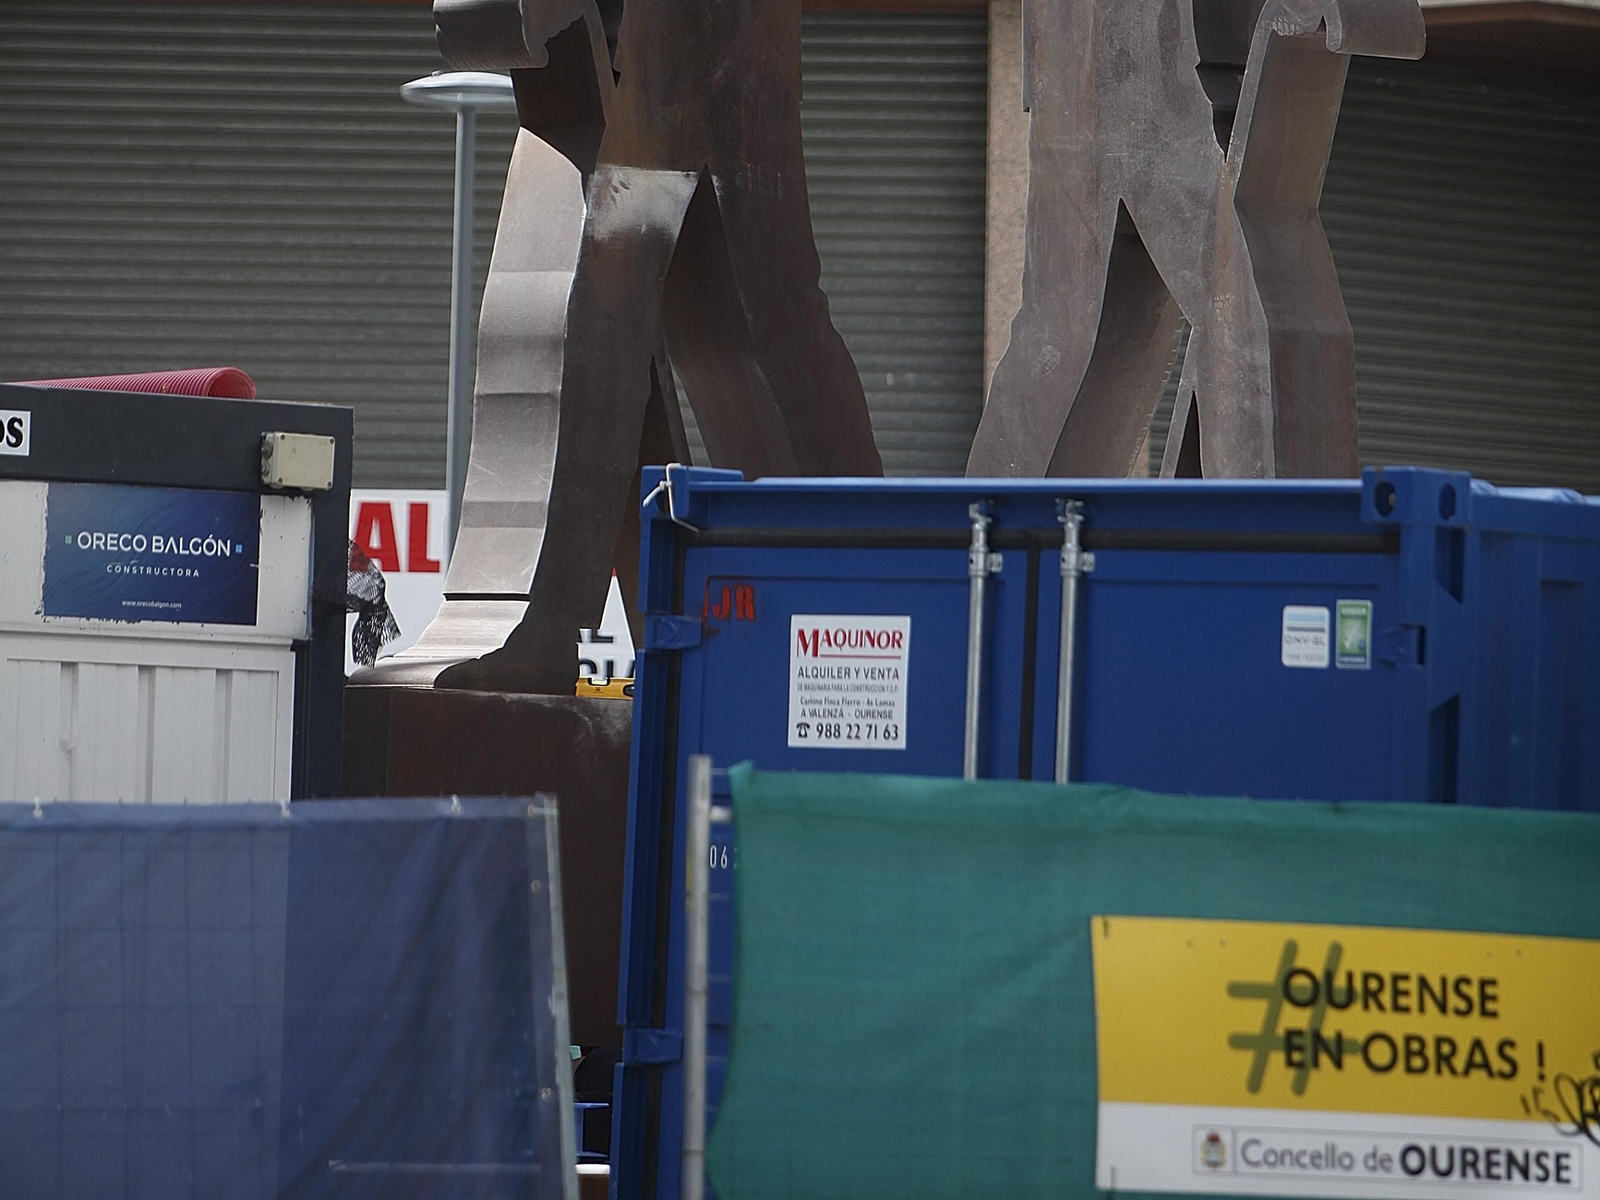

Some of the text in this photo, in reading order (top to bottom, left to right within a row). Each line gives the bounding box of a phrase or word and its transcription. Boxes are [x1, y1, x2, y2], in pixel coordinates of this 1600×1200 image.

[0, 416, 24, 448] S
[77, 531, 231, 557] ORECO BALGÓN
[106, 564, 200, 577] CONSTRUCTORA
[121, 600, 182, 610] www.orecobalgon.com
[711, 585, 756, 621] JR
[797, 628, 903, 657] MAQUINOR
[798, 666, 899, 680] ALQUILER Y VENTA
[800, 708, 806, 718] A
[854, 708, 893, 720] OURENSE
[816, 723, 898, 741] 988 22 71 63
[1282, 967, 1499, 1018] OURENSE
[1284, 1028, 1344, 1071] EN
[1360, 1031, 1519, 1080] OBRAS
[1240, 1137, 1572, 1184] Concello de OURENSE
